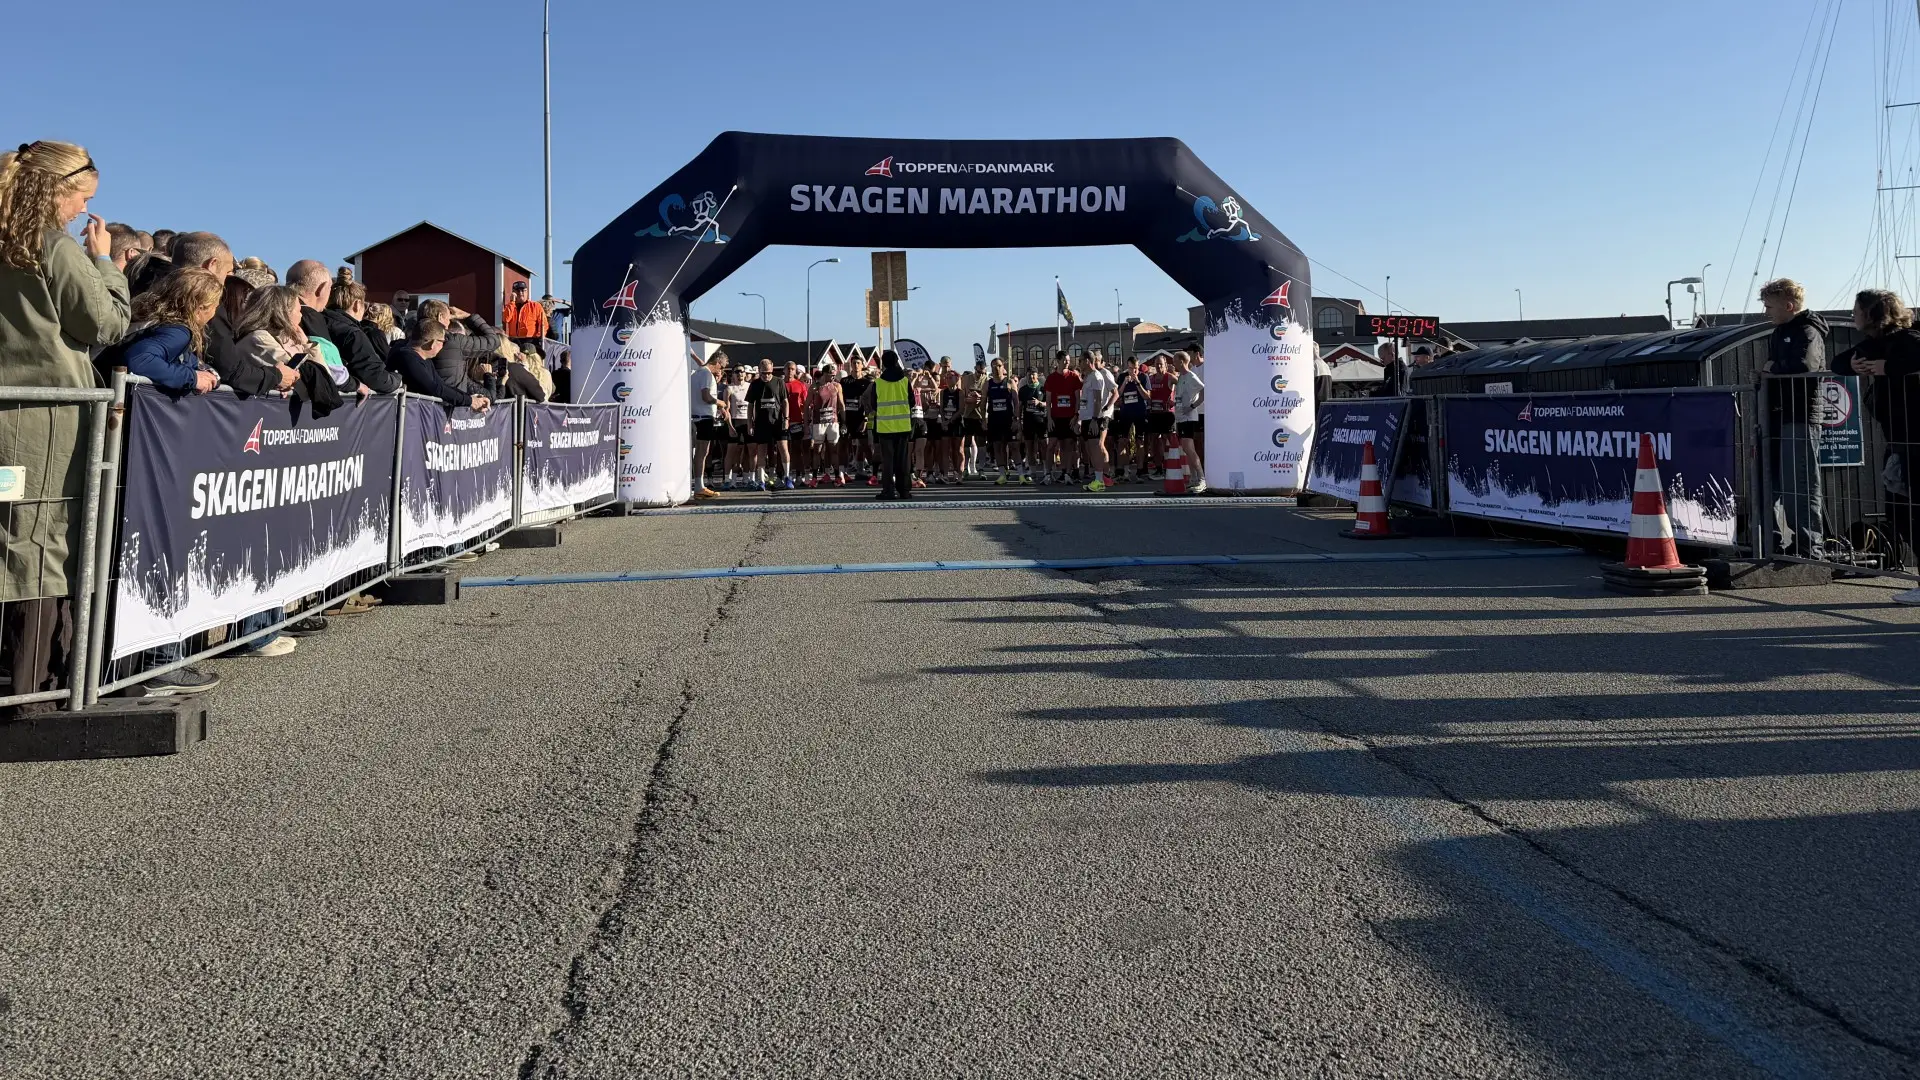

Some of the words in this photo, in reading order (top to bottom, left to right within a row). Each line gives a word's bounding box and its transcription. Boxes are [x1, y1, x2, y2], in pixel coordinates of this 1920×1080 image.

[896, 161, 1055, 174] TOPPENAFDANMARK
[790, 184, 929, 214] SKAGEN
[939, 185, 1126, 214] MARATHON
[1371, 317, 1436, 336] 9:58:04
[623, 348, 652, 360] Hotel
[902, 347, 923, 358] 3:30
[1251, 343, 1278, 355] Color
[1280, 343, 1302, 355] Hotel
[1252, 397, 1280, 408] Color
[1280, 397, 1303, 408] Hotel
[622, 404, 652, 417] Hotel
[1533, 405, 1625, 417] TOPPENAFDANMARK
[262, 427, 340, 446] TOPPENAFDANMARK
[1484, 429, 1551, 455] SKAGEN
[425, 440, 460, 472] SKAGEN
[460, 437, 499, 471] MARATHON
[1253, 450, 1281, 462] Color
[1282, 450, 1304, 462] Hotel
[622, 462, 652, 475] Hotel
[191, 467, 278, 519] SKAGEN
[280, 454, 364, 506] MARATHON
